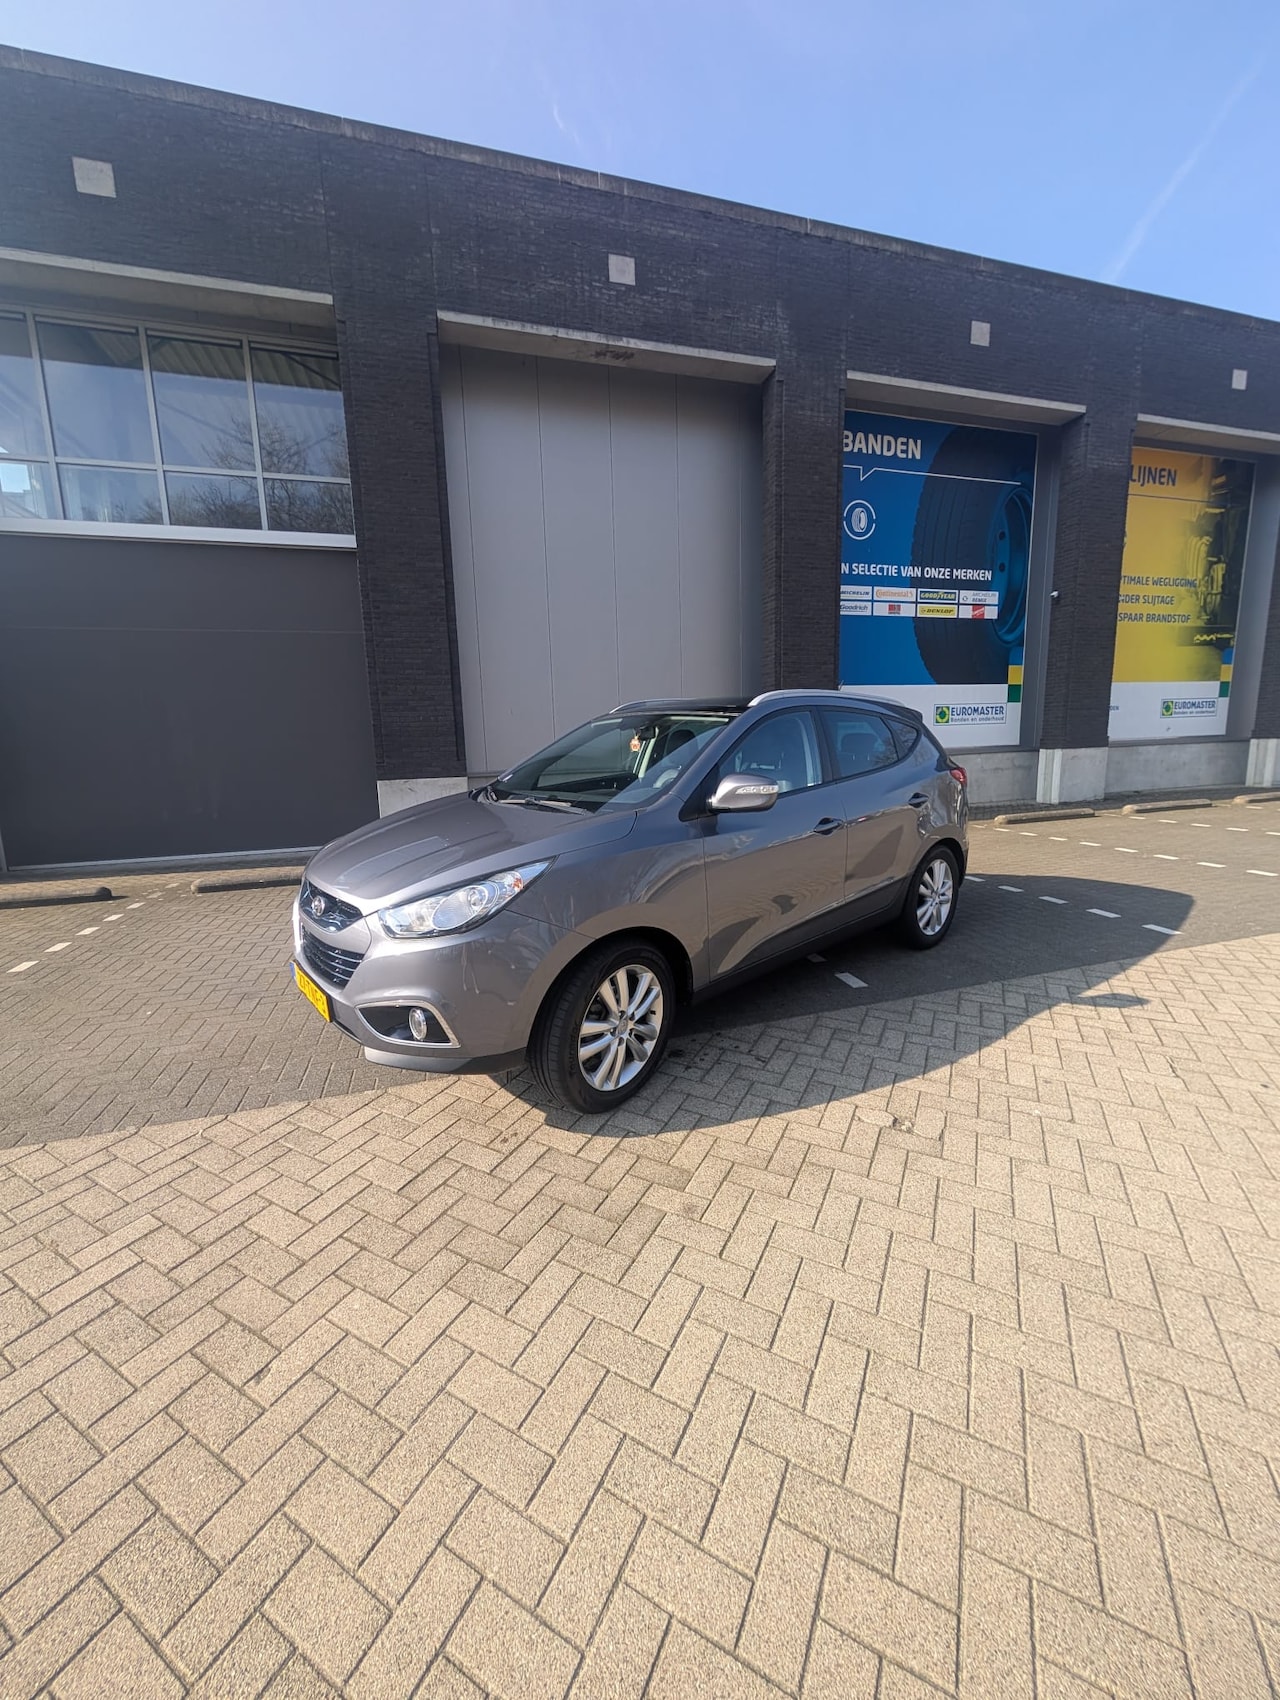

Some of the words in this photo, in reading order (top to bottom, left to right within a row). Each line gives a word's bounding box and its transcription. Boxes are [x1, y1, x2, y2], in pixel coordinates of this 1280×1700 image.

[842, 430, 921, 460] BANDEN
[852, 562, 898, 577] SELECTIE
[900, 565, 922, 578] VAN
[924, 566, 951, 579] ONZE
[952, 568, 992, 581] MERKEN
[1121, 575, 1151, 586] TIMALE
[1152, 577, 1197, 588] WEGLIGGING
[920, 591, 956, 600] GOODYEAR
[1142, 594, 1175, 606] SLIJTAGE
[1146, 613, 1191, 624] BRANDSTOF
[1174, 700, 1216, 710] EUROMASTER
[950, 706, 1005, 716] EUROMASTER
